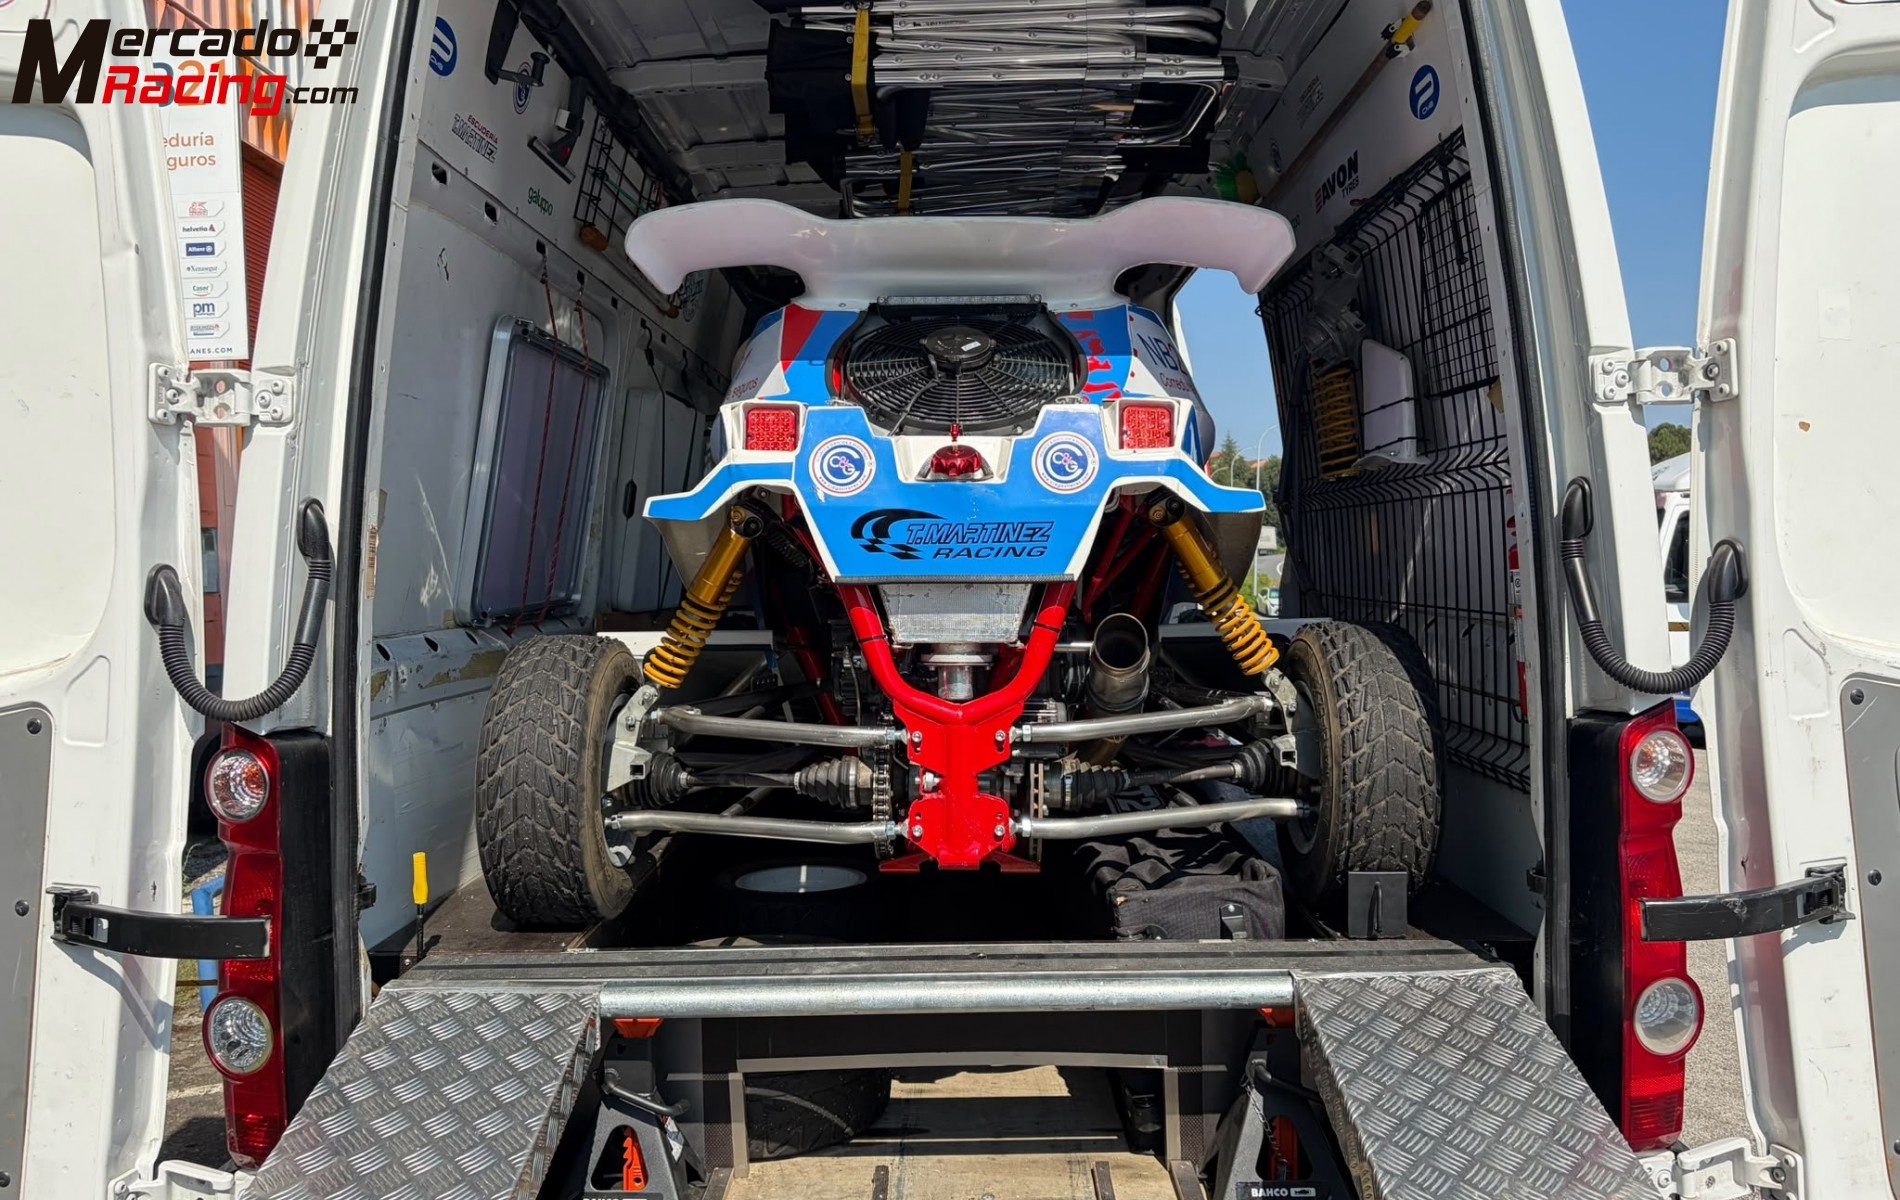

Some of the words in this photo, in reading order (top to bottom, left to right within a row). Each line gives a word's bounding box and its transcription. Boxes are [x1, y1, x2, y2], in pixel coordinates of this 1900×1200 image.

[167, 154, 217, 171] guros
[1321, 150, 1359, 206] AVON
[193, 302, 216, 318] pm
[188, 347, 233, 355] ANES.COM
[906, 521, 1055, 545] T.MARTINEZ
[931, 546, 1049, 560] RACING
[1251, 1187, 1288, 1198] BAHCO
